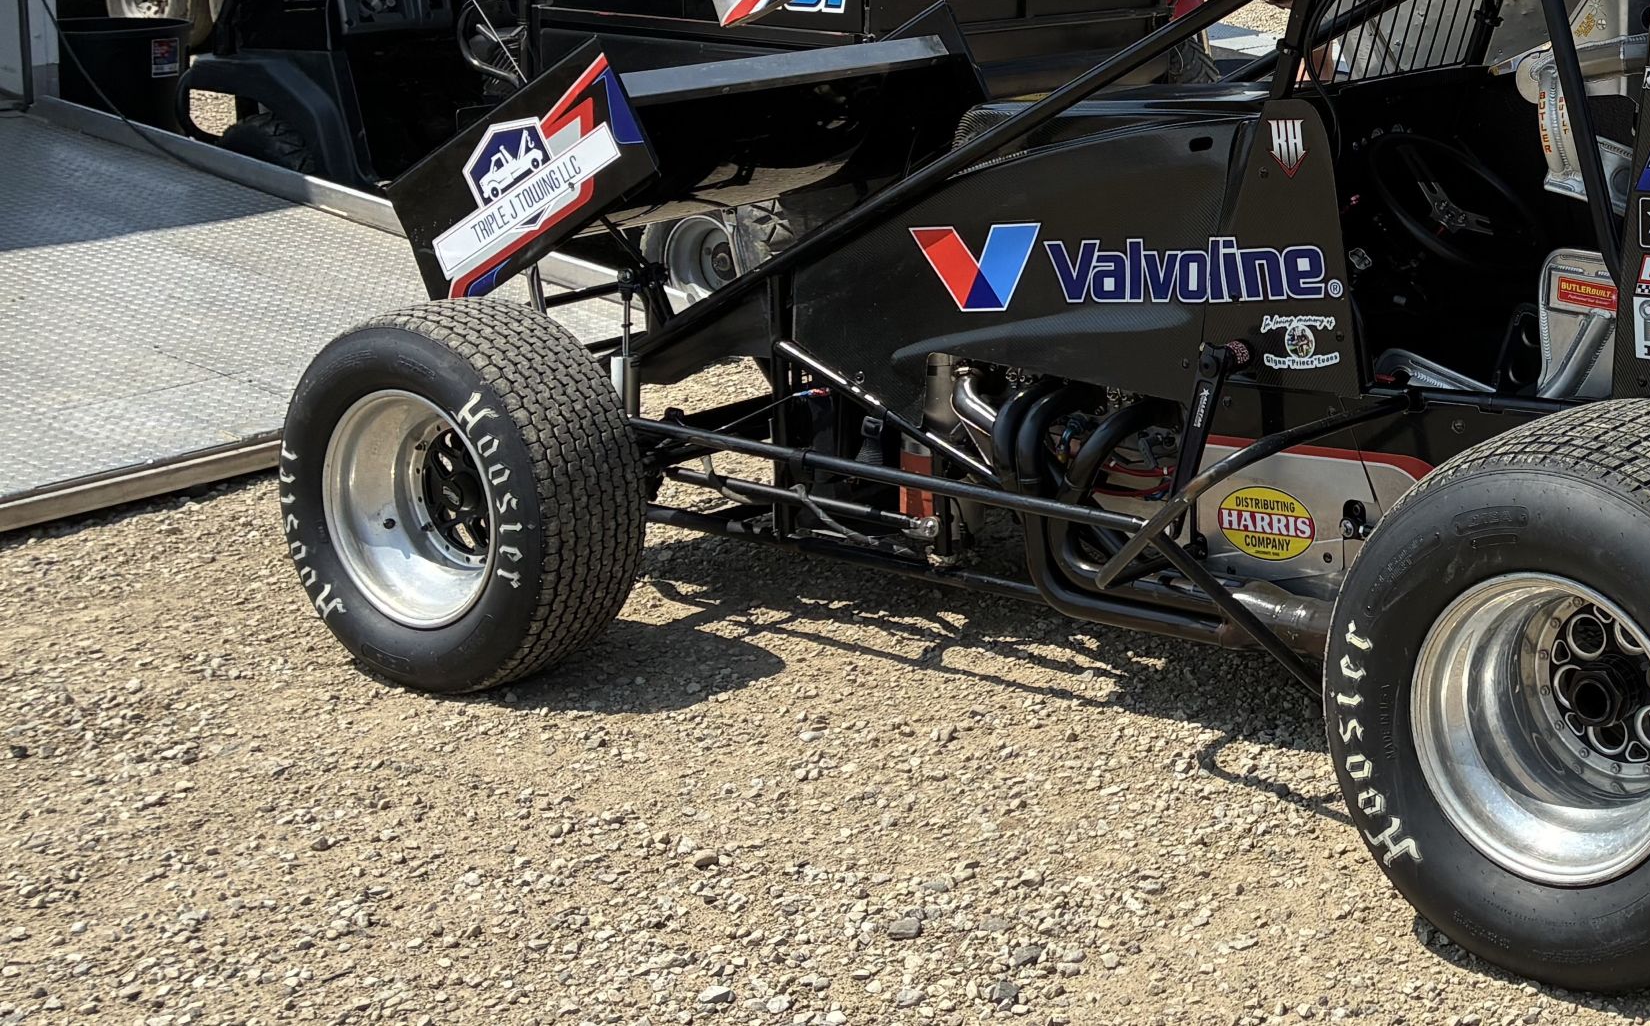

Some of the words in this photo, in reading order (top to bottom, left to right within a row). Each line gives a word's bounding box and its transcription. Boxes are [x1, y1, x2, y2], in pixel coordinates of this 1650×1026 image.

[1539, 91, 1552, 154] BUTLER
[1558, 96, 1570, 136] BUILT
[470, 205, 511, 244] TRIPLE
[510, 199, 518, 220] J
[515, 168, 561, 213] TOWING
[559, 155, 582, 184] LLC
[1044, 236, 1326, 304] Valvoline
[1561, 281, 1612, 298] BUTLERBUILT
[457, 391, 536, 590] Hoosier
[1235, 496, 1296, 514] DISTRIBUTING
[279, 440, 347, 619] Hoosier
[1221, 509, 1311, 538] HARRIS
[1244, 534, 1292, 552] COMPANY
[1329, 619, 1423, 868] Hoosier
